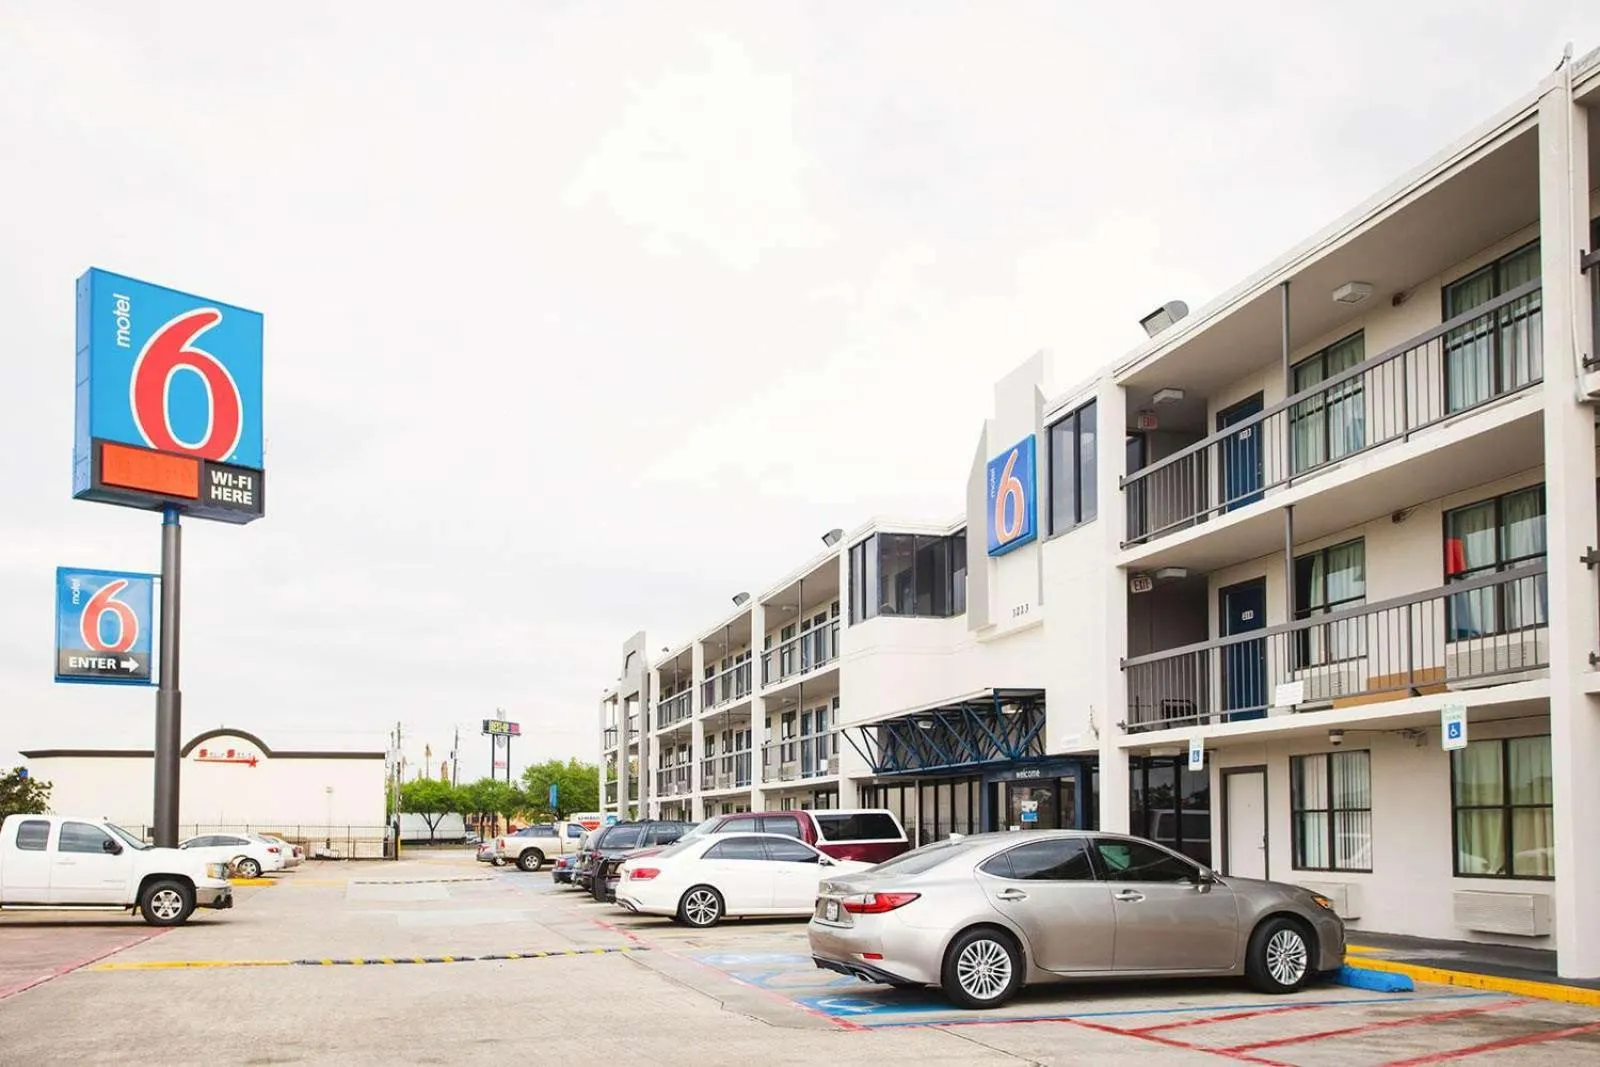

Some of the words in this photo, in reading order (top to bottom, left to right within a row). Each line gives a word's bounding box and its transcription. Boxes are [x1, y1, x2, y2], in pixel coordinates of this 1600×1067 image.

[113, 293, 131, 348] motel
[129, 307, 243, 462] 6
[211, 470, 252, 490] WI-FI
[211, 486, 252, 505] HERE
[995, 448, 1025, 544] 6
[80, 578, 139, 653] 6
[68, 656, 117, 670] ENTER
[1016, 767, 1040, 779] welcome
